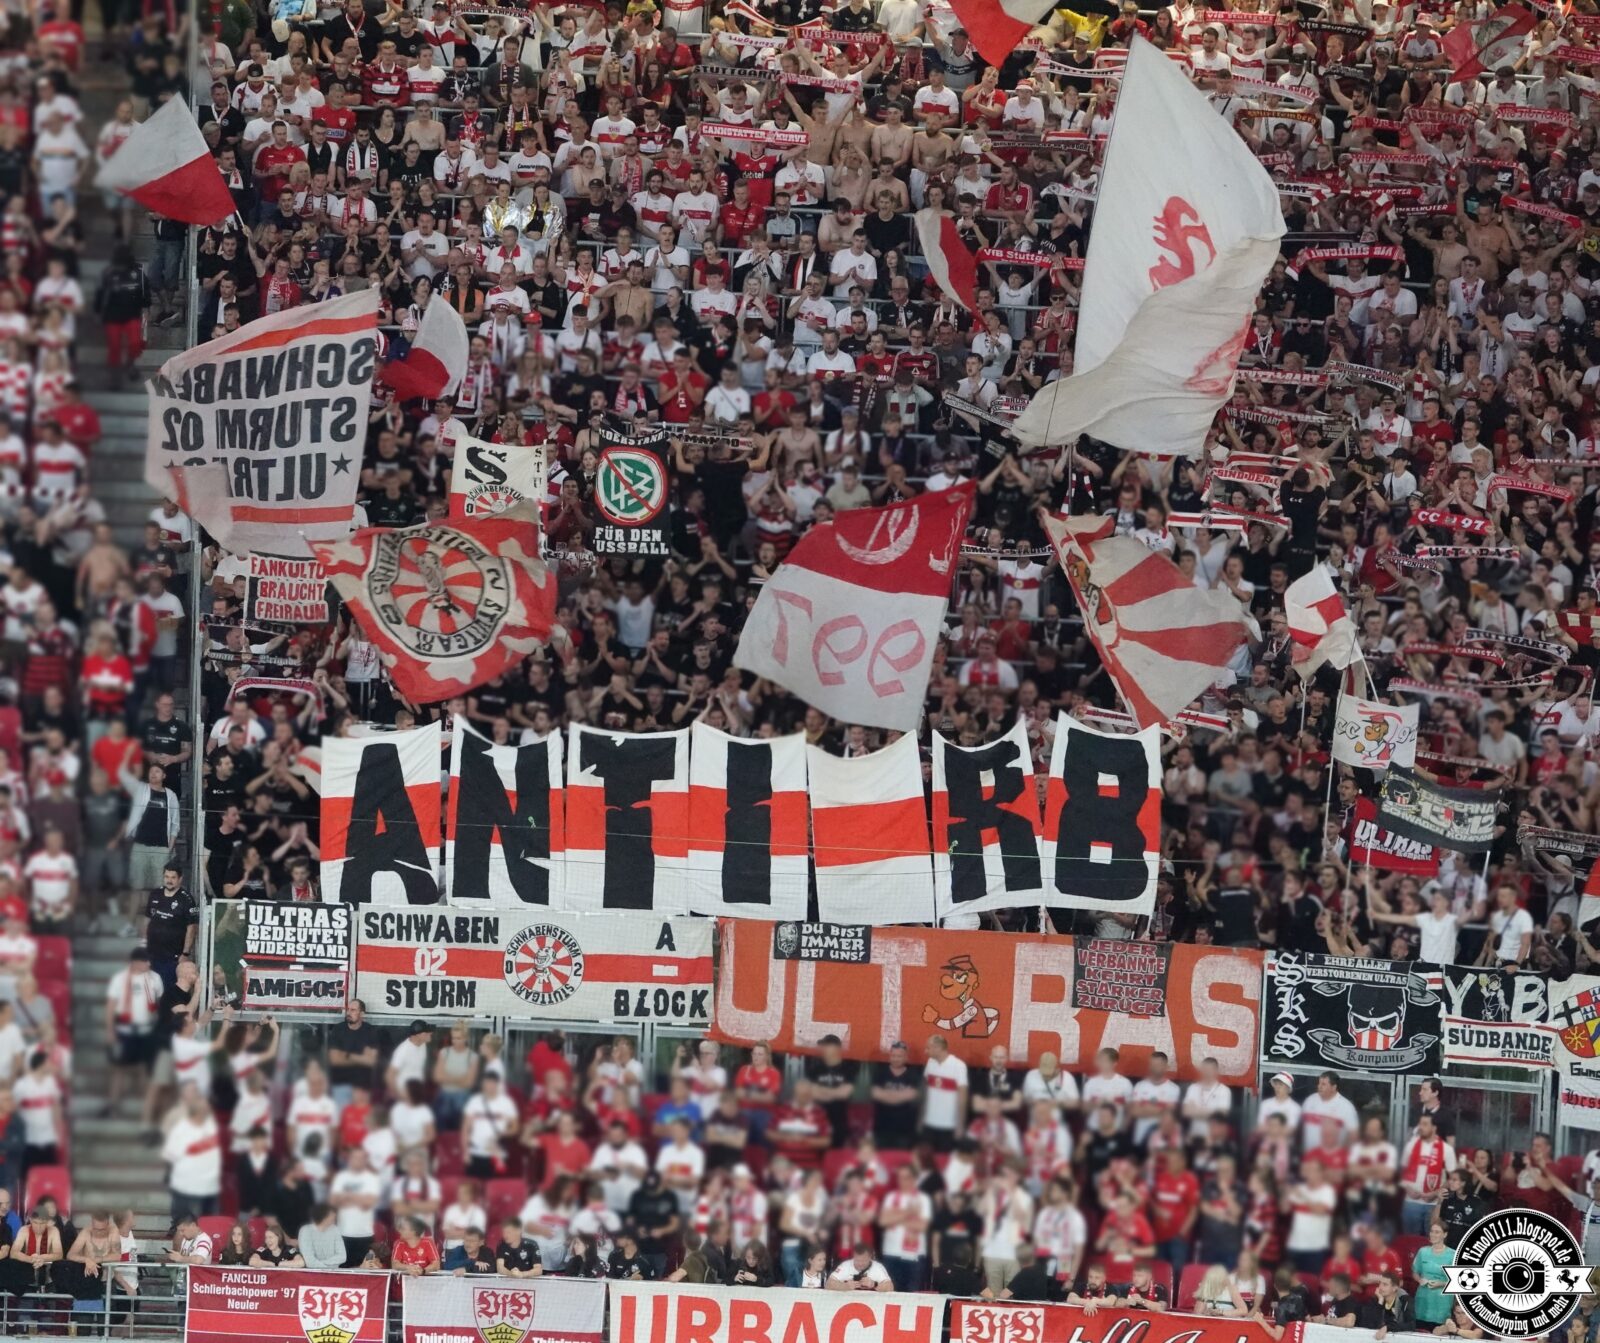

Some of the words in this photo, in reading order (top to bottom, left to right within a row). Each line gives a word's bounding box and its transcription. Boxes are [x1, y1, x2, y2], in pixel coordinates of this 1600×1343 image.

[1299, 21, 1319, 30] VfB
[825, 30, 882, 44] STUTTGART
[702, 125, 766, 141] CANNSTATTER
[776, 132, 807, 144] KURVE
[984, 248, 1004, 257] VfB
[1239, 410, 1283, 427] STUTTGART
[1417, 510, 1441, 523] CC
[1461, 517, 1485, 531] 97
[595, 526, 625, 542] FÜR
[631, 528, 663, 542] DEN
[250, 556, 327, 579] FANKULTU
[259, 580, 325, 601] BRAUCHT
[256, 602, 326, 621] FREIRAUM
[1466, 627, 1552, 649] STUTTGART
[1420, 788, 1495, 814] DEZERNA
[340, 729, 773, 910] ANTI
[944, 727, 1150, 904] RB
[1355, 819, 1433, 855] ULTRAS
[248, 904, 348, 929] ULTRAS
[247, 924, 348, 945] BEDEUTET
[364, 911, 499, 945] SCHWABEN
[656, 922, 676, 951] A
[801, 923, 823, 935] DU
[830, 925, 866, 938] BIST
[246, 940, 348, 958] WIDERSTAND
[507, 925, 581, 958] SCHWABENSTURM
[801, 935, 865, 951] IMMER
[1088, 940, 1157, 957] JEDER
[414, 948, 448, 977] 02
[801, 948, 824, 958] BEI
[829, 951, 866, 961] UNS!
[1077, 949, 1166, 974] VERBANNTE
[1324, 956, 1354, 968] EHRE
[1356, 957, 1391, 972] ALLEN
[505, 960, 513, 974] 0
[573, 962, 583, 977] 2
[1085, 967, 1158, 986] KEHRT
[1307, 968, 1374, 982] VERSTORBENEN
[1375, 970, 1409, 986] ULTRAS
[385, 978, 476, 1009] STURM
[511, 981, 575, 1005] STUTTGART
[613, 989, 710, 1019] BLOCK
[1077, 993, 1162, 1016] ZURÜCK
[1448, 1024, 1553, 1055] SÜDBANDE
[1346, 1048, 1406, 1065] Kompanie
[1500, 1049, 1552, 1063] STUTTGART
[221, 1272, 268, 1284] FANCLUB
[192, 1282, 278, 1299] Schlierbachpower
[280, 1287, 296, 1299] '97
[227, 1298, 260, 1311] Neuler
[302, 1288, 366, 1323] VfB
[477, 1289, 533, 1321] VfB
[618, 1294, 933, 1343] URBACH
[414, 1332, 475, 1343] Thüringer
